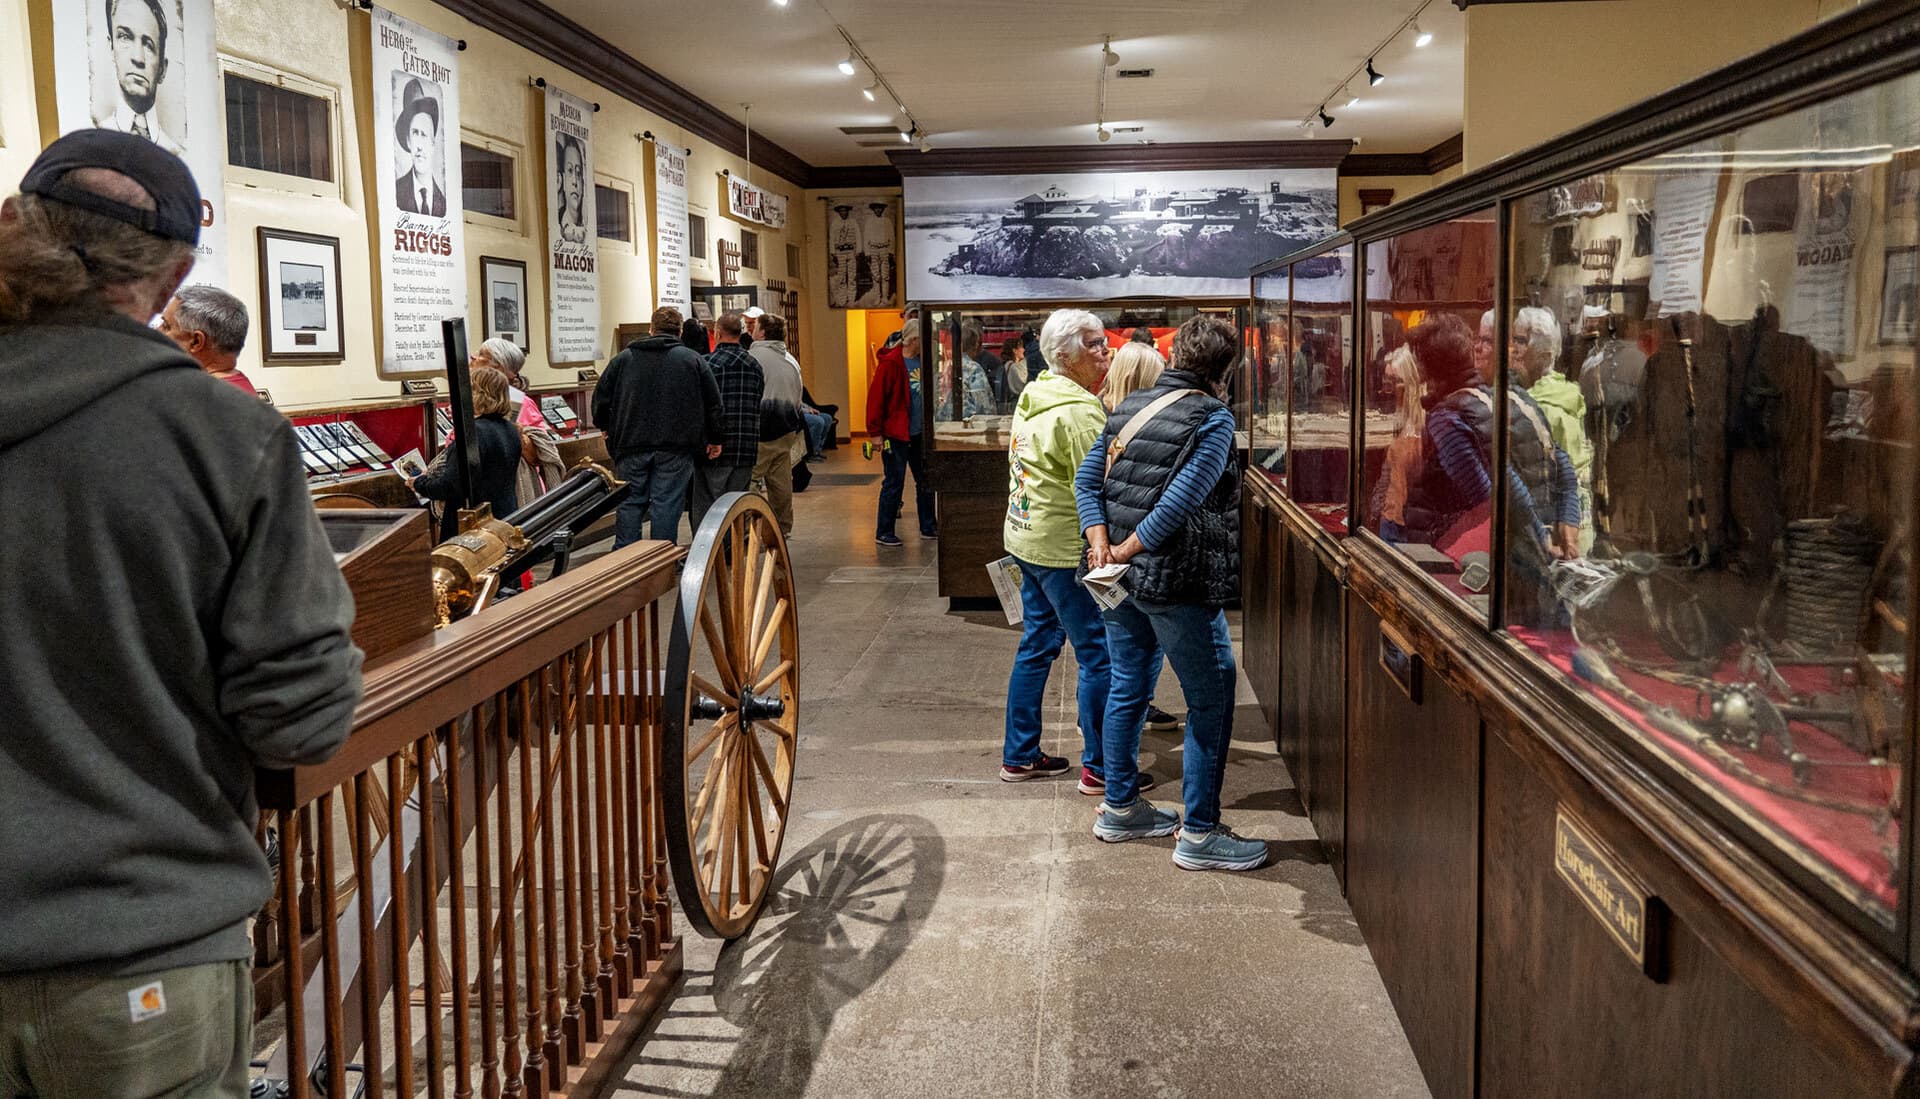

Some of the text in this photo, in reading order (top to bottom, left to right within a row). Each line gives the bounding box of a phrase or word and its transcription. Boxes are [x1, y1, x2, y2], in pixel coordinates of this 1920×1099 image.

[380, 24, 405, 51] HERO
[406, 44, 418, 54] THE
[402, 50, 452, 84] GATES RIOT
[559, 101, 582, 122] MEXICAN
[550, 113, 589, 141] REVOLUTIONARY
[743, 191, 757, 206] EXIT
[394, 228, 452, 256] RIGGS
[553, 252, 594, 273] MAGON
[1558, 830, 1639, 942] Horsehair Art
